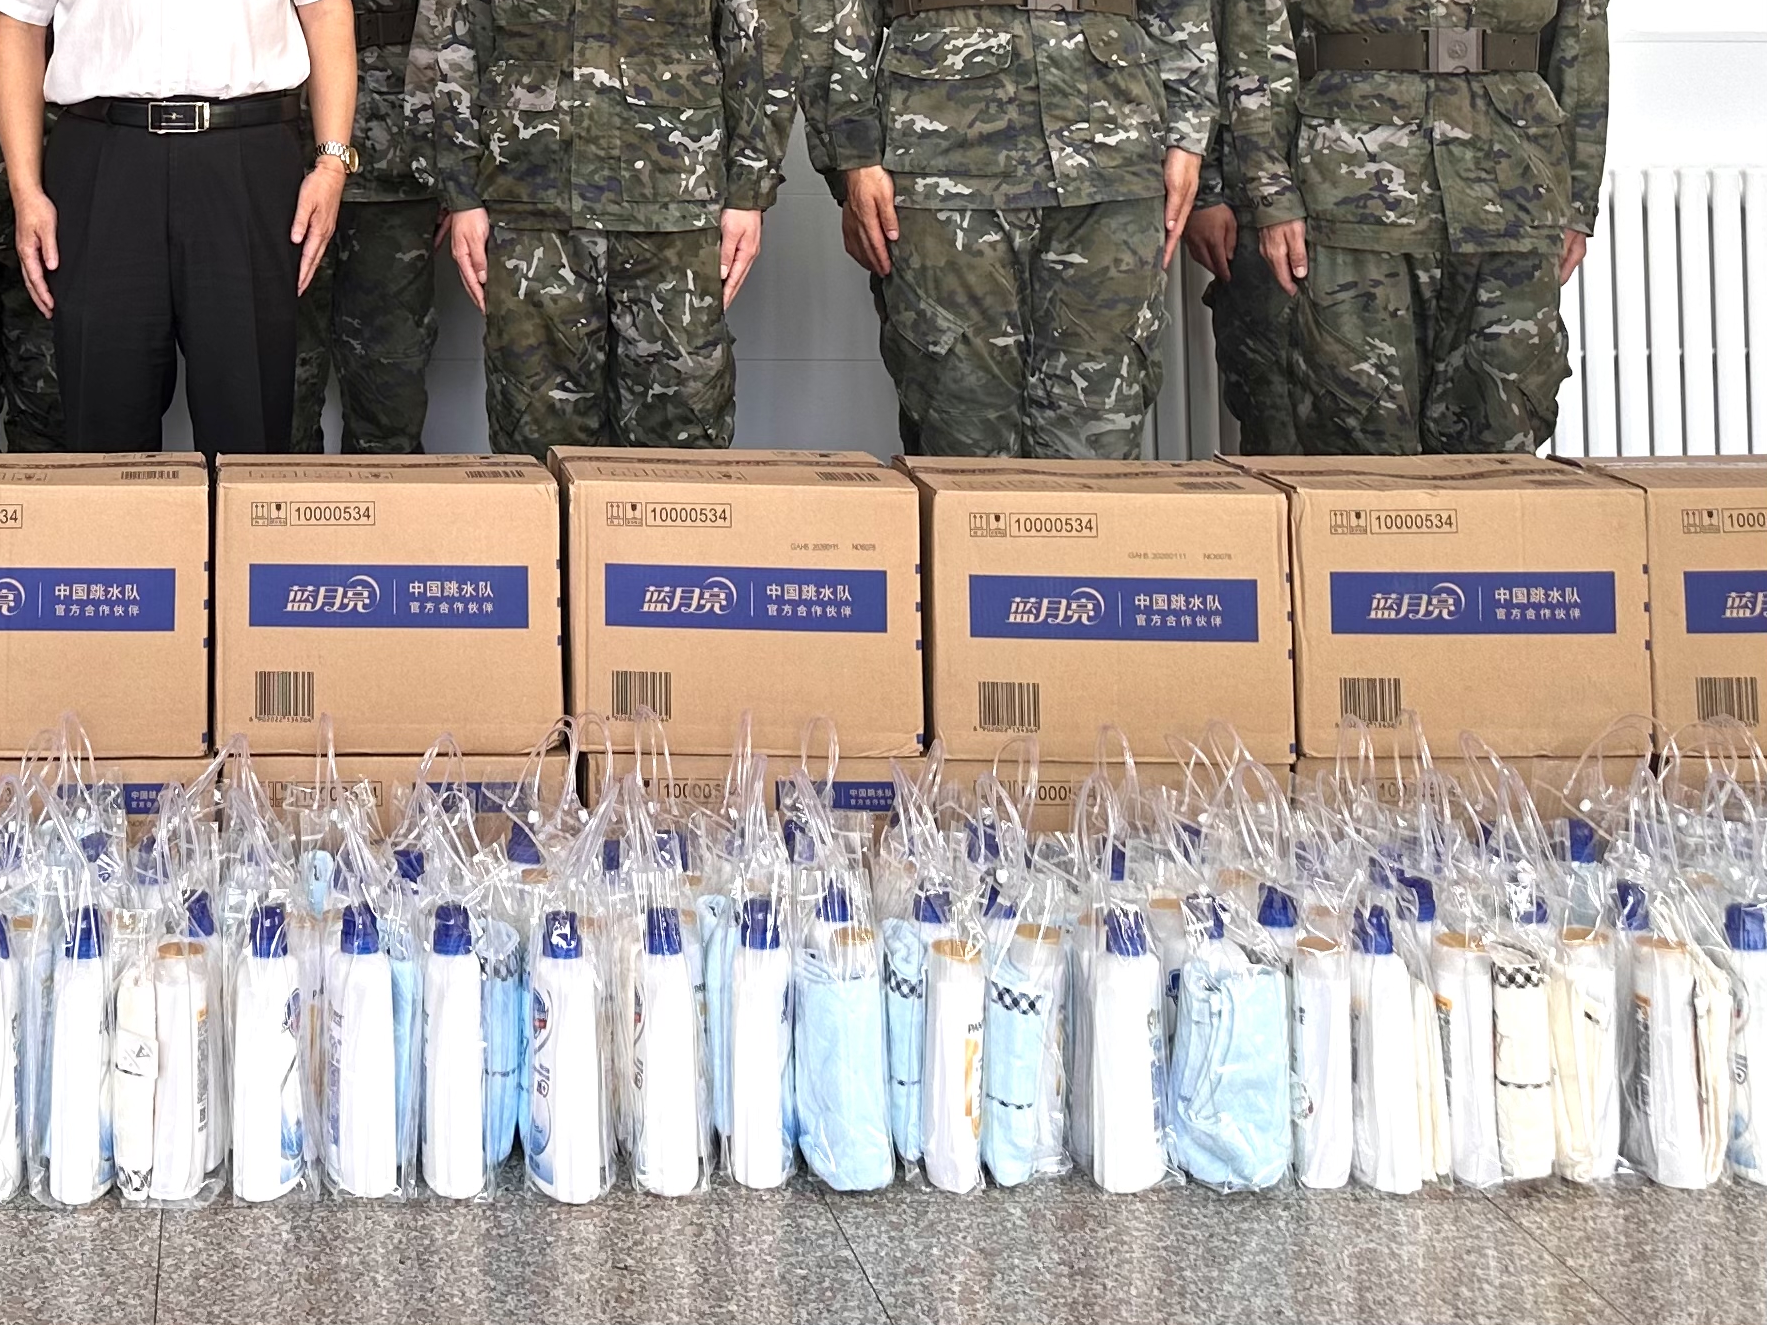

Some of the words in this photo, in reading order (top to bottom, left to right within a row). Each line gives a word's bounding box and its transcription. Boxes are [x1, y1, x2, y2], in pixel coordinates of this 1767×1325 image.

[295, 506, 371, 522] 10000534
[650, 507, 727, 524] 10000534
[1374, 513, 1454, 530] 10000534
[1014, 517, 1093, 534] 10000534
[55, 583, 140, 601] 中国跳水队
[284, 576, 380, 612] 蓝月亮
[409, 580, 494, 598] 中国跳水队
[641, 577, 737, 614] 蓝月亮
[766, 583, 852, 601] 中国跳水队
[1495, 587, 1581, 604] 中国跳水队
[409, 601, 494, 614] 官方合作伙伴
[1007, 588, 1105, 625] 蓝月亮
[1134, 593, 1222, 611] 中国跳水队
[1368, 583, 1465, 620] 蓝月亮
[55, 604, 139, 617] 官方合作伙伴
[767, 604, 851, 617] 官方合作伙伴
[1496, 607, 1580, 620] 官方合作伙伴
[1135, 614, 1222, 627] 官方合作伙伴
